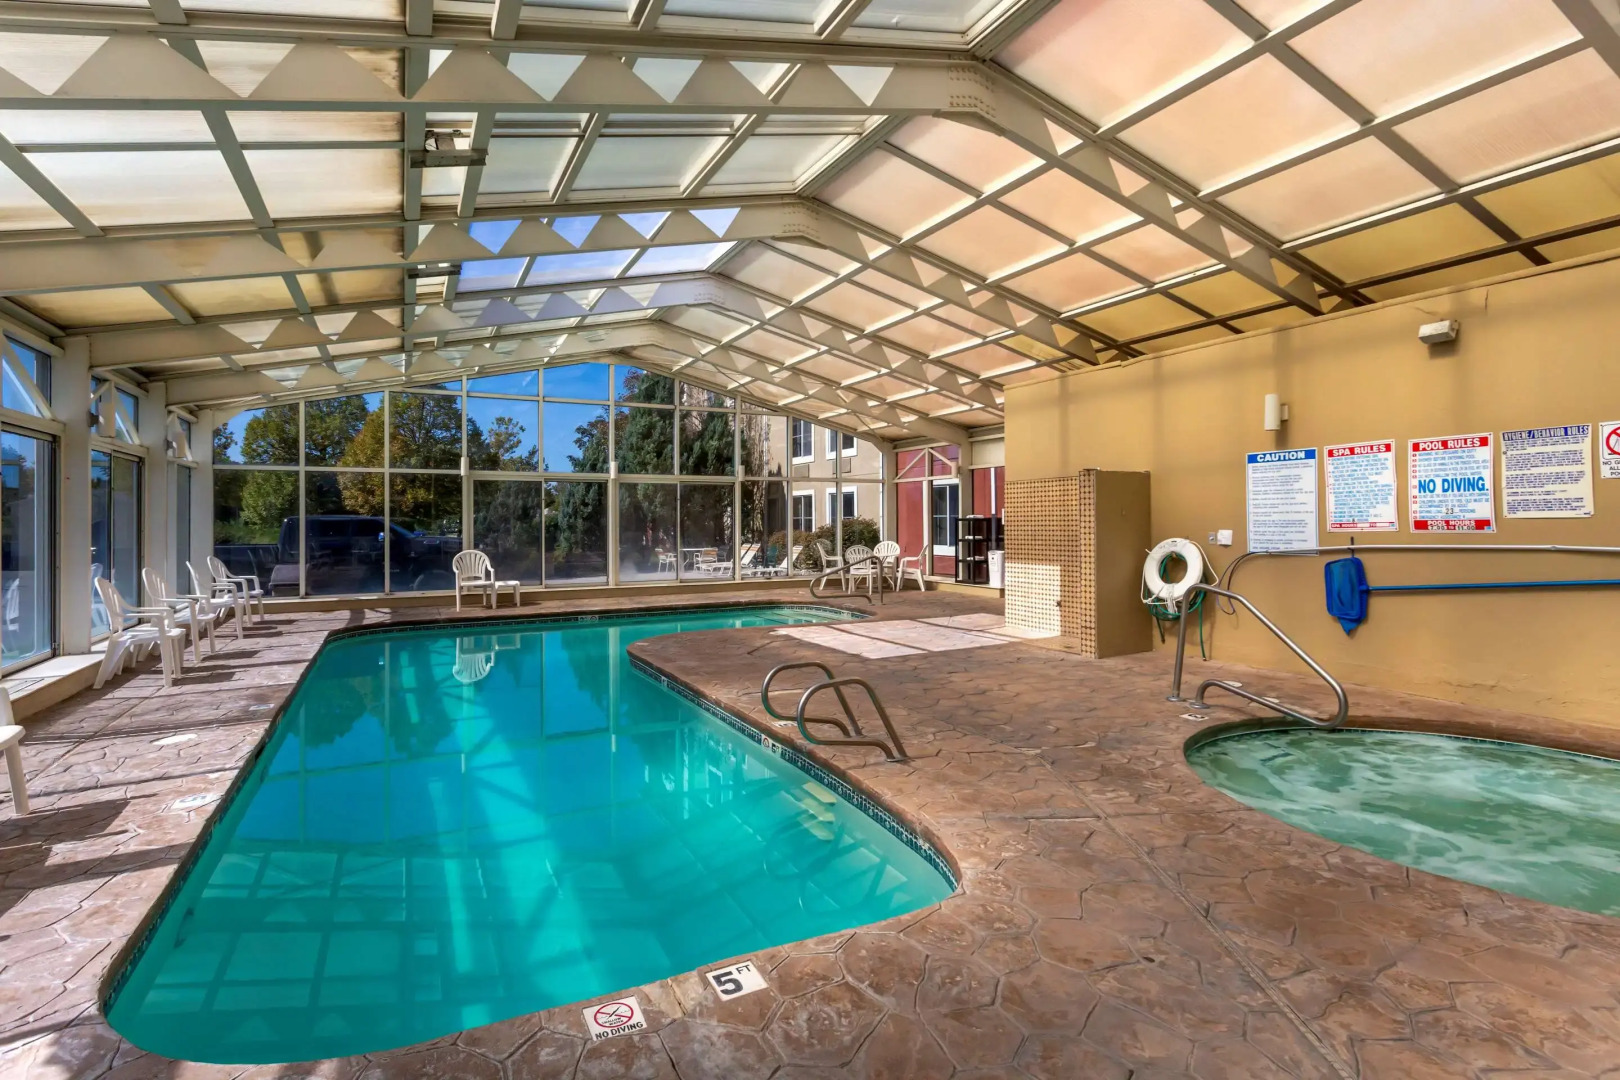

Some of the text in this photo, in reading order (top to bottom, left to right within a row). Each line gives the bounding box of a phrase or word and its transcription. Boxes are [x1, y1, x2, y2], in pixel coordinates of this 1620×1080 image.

[1503, 425, 1589, 440] HYGIENE/BEHAVIOR RULES
[1332, 444, 1386, 457] SPA RULES
[1419, 437, 1480, 451] POOL RULES
[1256, 450, 1306, 462] CAUTION
[1418, 476, 1489, 493] NO DIVING.
[1445, 507, 1454, 515] 23
[711, 964, 752, 995] 5 FT
[595, 1021, 644, 1040] NO DIVING
